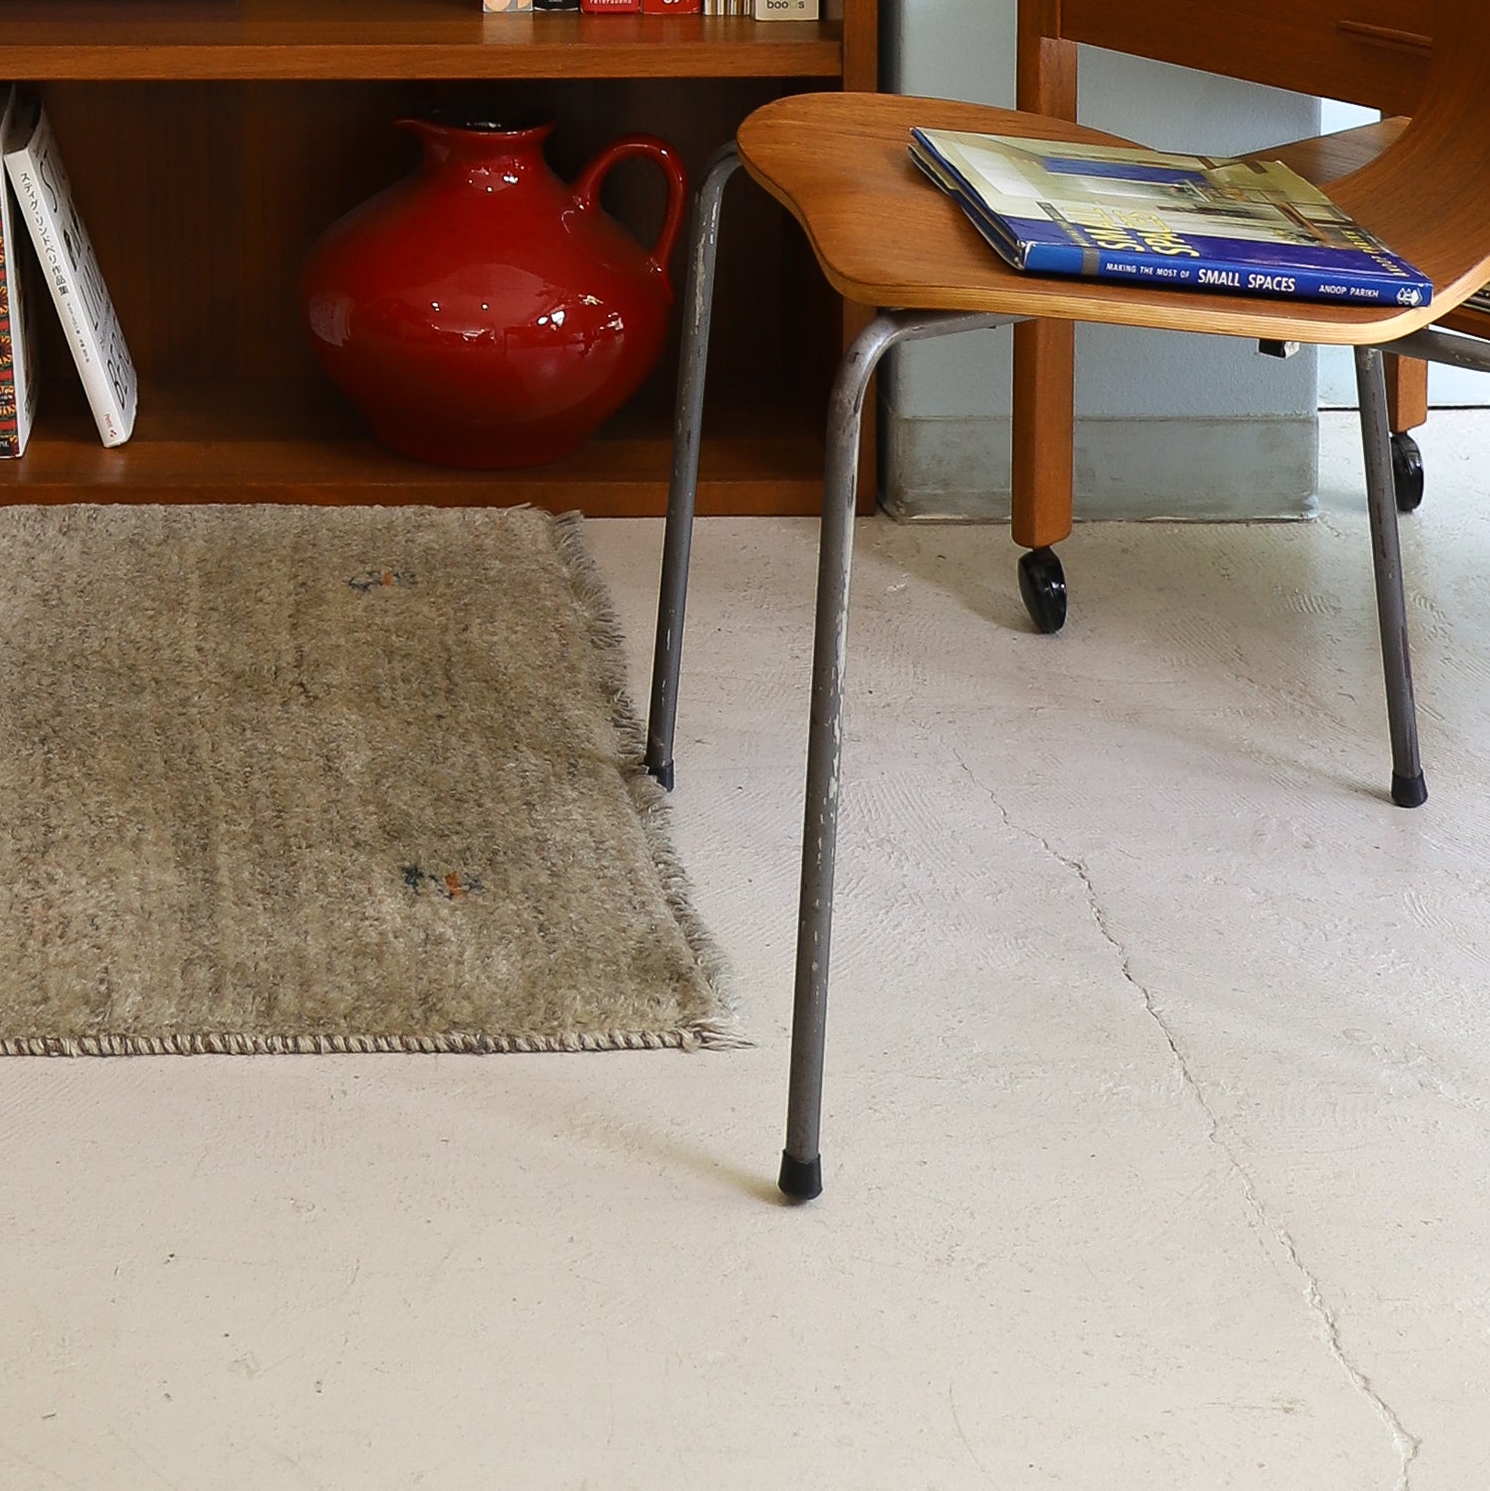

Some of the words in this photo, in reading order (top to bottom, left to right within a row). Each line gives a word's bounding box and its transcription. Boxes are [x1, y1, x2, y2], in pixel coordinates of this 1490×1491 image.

[1106, 262, 1138, 274] MAKING
[1140, 265, 1154, 275] THE
[1156, 267, 1178, 277] MOST
[1180, 269, 1190, 279] OF
[1197, 268, 1242, 288] SMALL
[1248, 273, 1296, 293] SPACES
[1318, 284, 1348, 297] ANOOP
[1349, 286, 1380, 300] PARIKH
